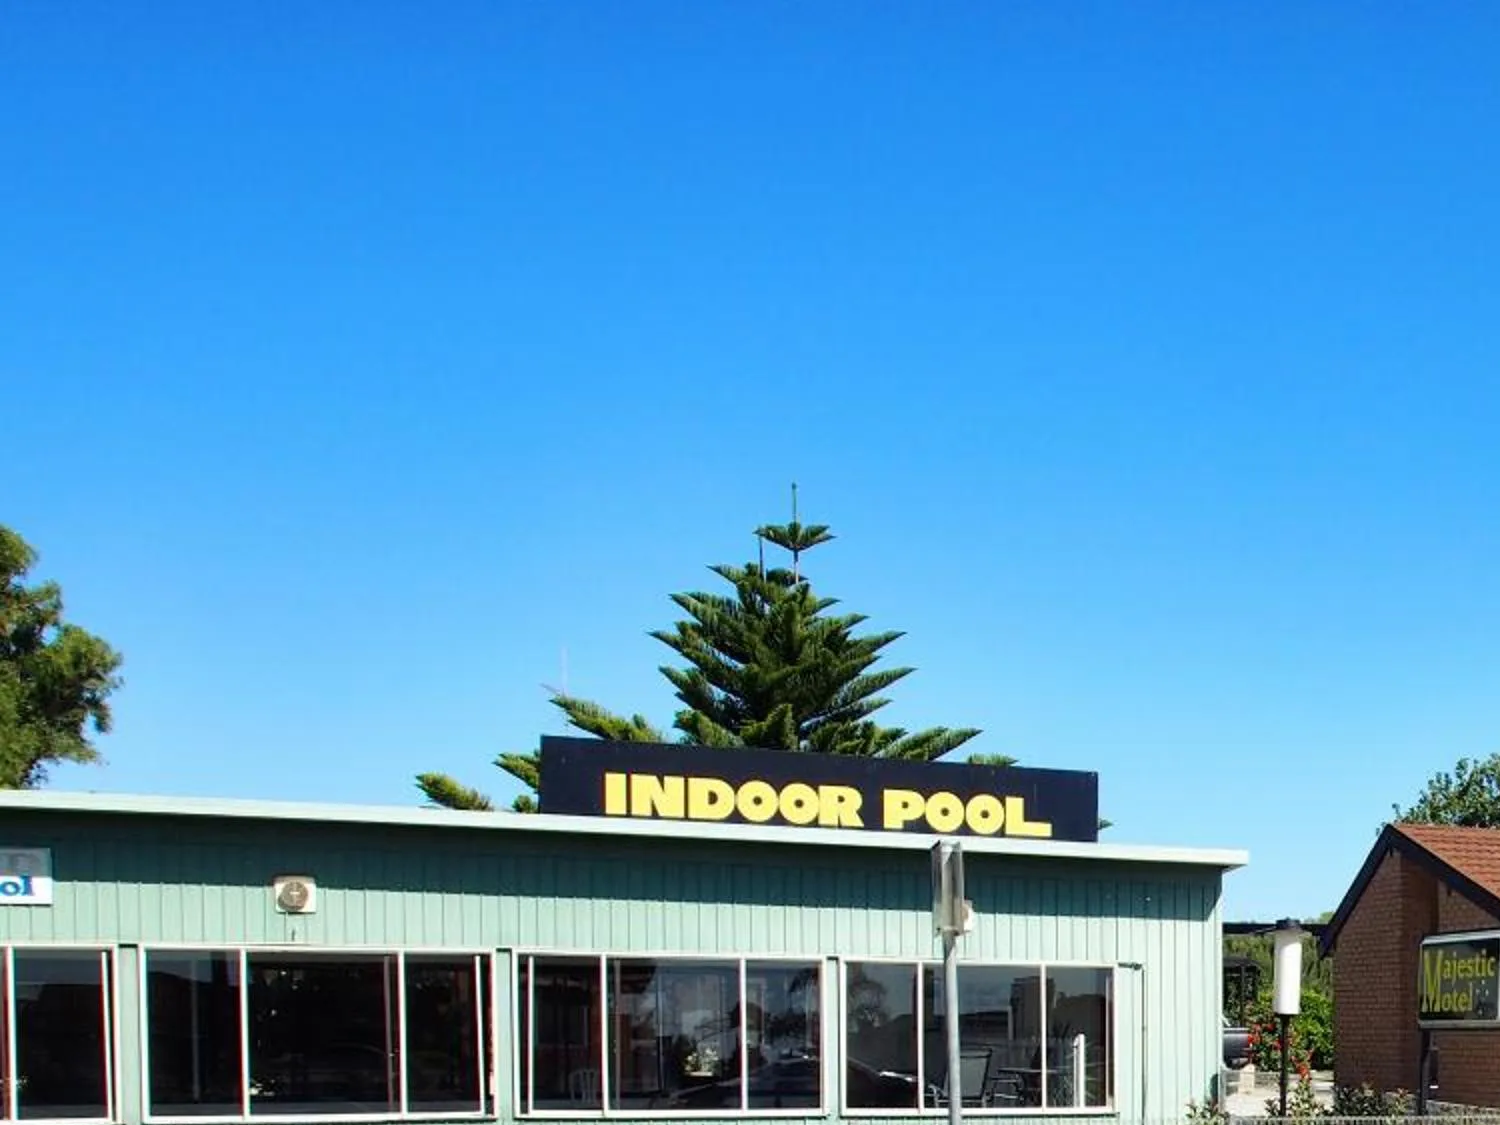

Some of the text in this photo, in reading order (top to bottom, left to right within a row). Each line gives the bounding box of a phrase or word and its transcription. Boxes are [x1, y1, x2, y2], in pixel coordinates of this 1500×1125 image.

[605, 772, 1053, 838] INDOOR POOL
[1423, 948, 1496, 991] Majestic
[1421, 981, 1474, 1013] Motel
